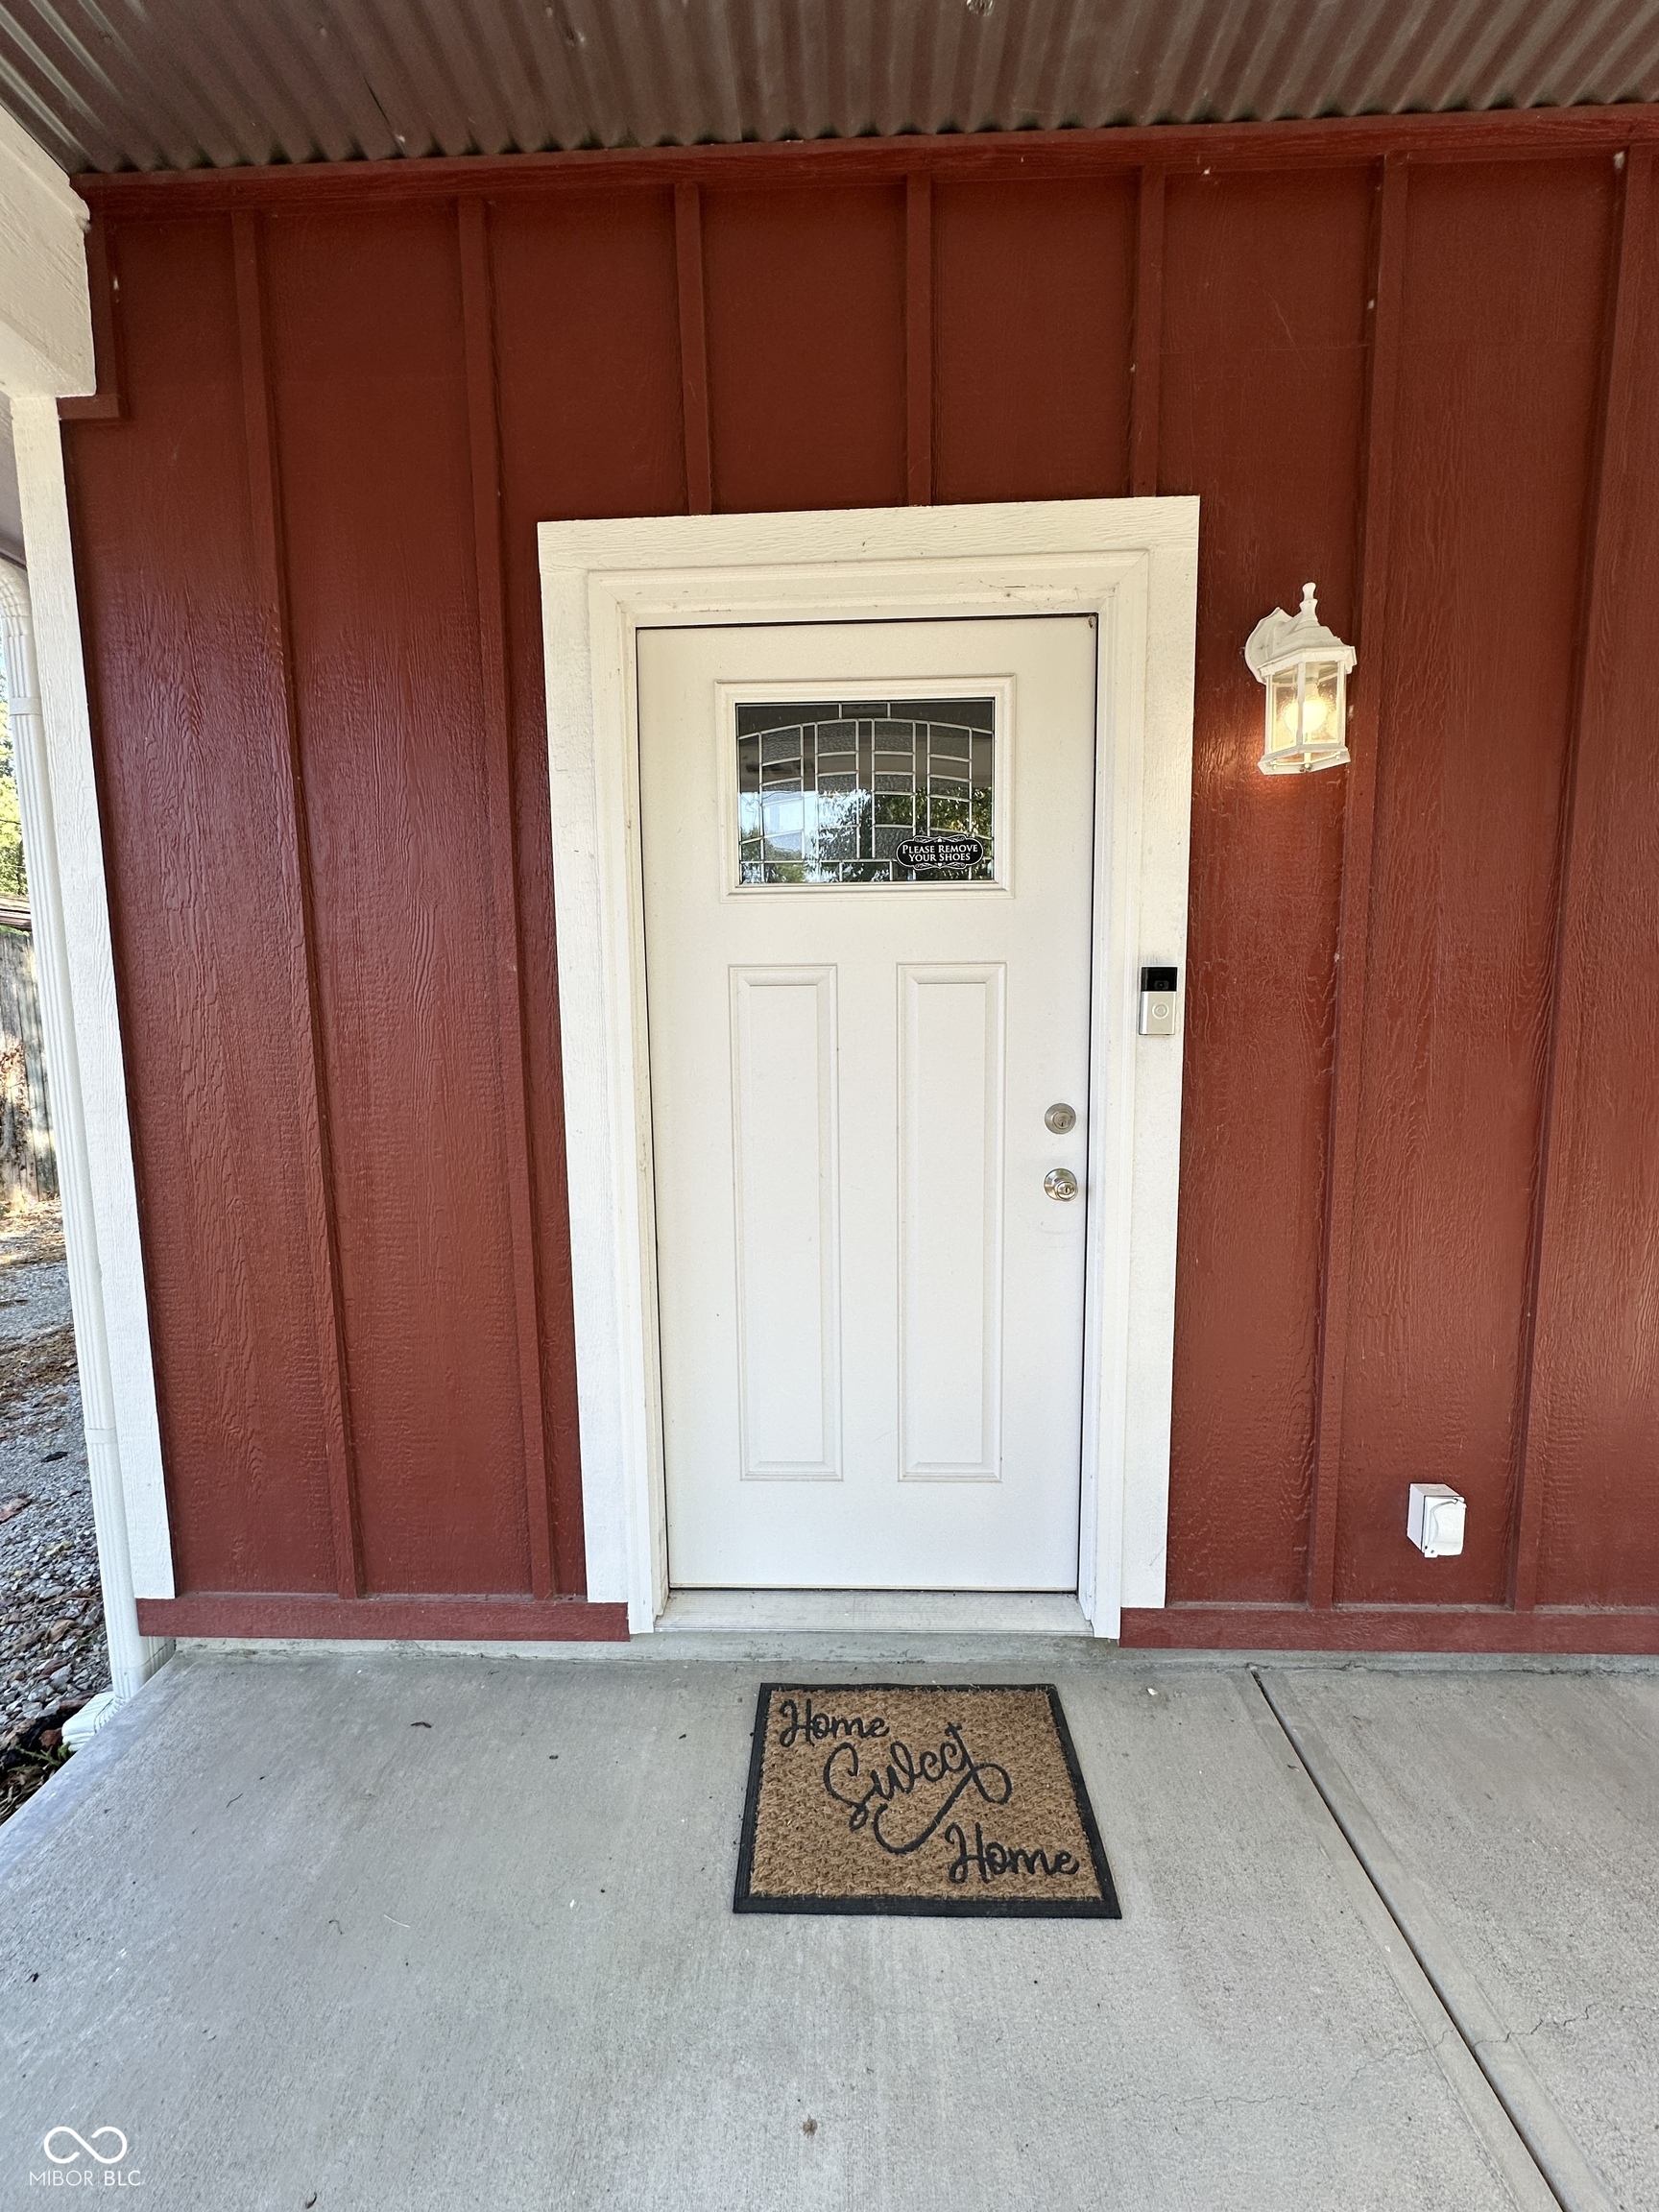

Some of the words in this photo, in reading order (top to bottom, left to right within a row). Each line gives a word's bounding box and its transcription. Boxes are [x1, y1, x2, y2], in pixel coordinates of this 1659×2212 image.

[902, 844, 935, 854] PLEASE
[938, 844, 978, 854] REMOVE
[908, 854, 937, 862] YOUR
[939, 853, 971, 861] SHOES
[780, 1698, 890, 1747] Home
[824, 1722, 1012, 1855] Sweet
[945, 1822, 1079, 1885] Home
